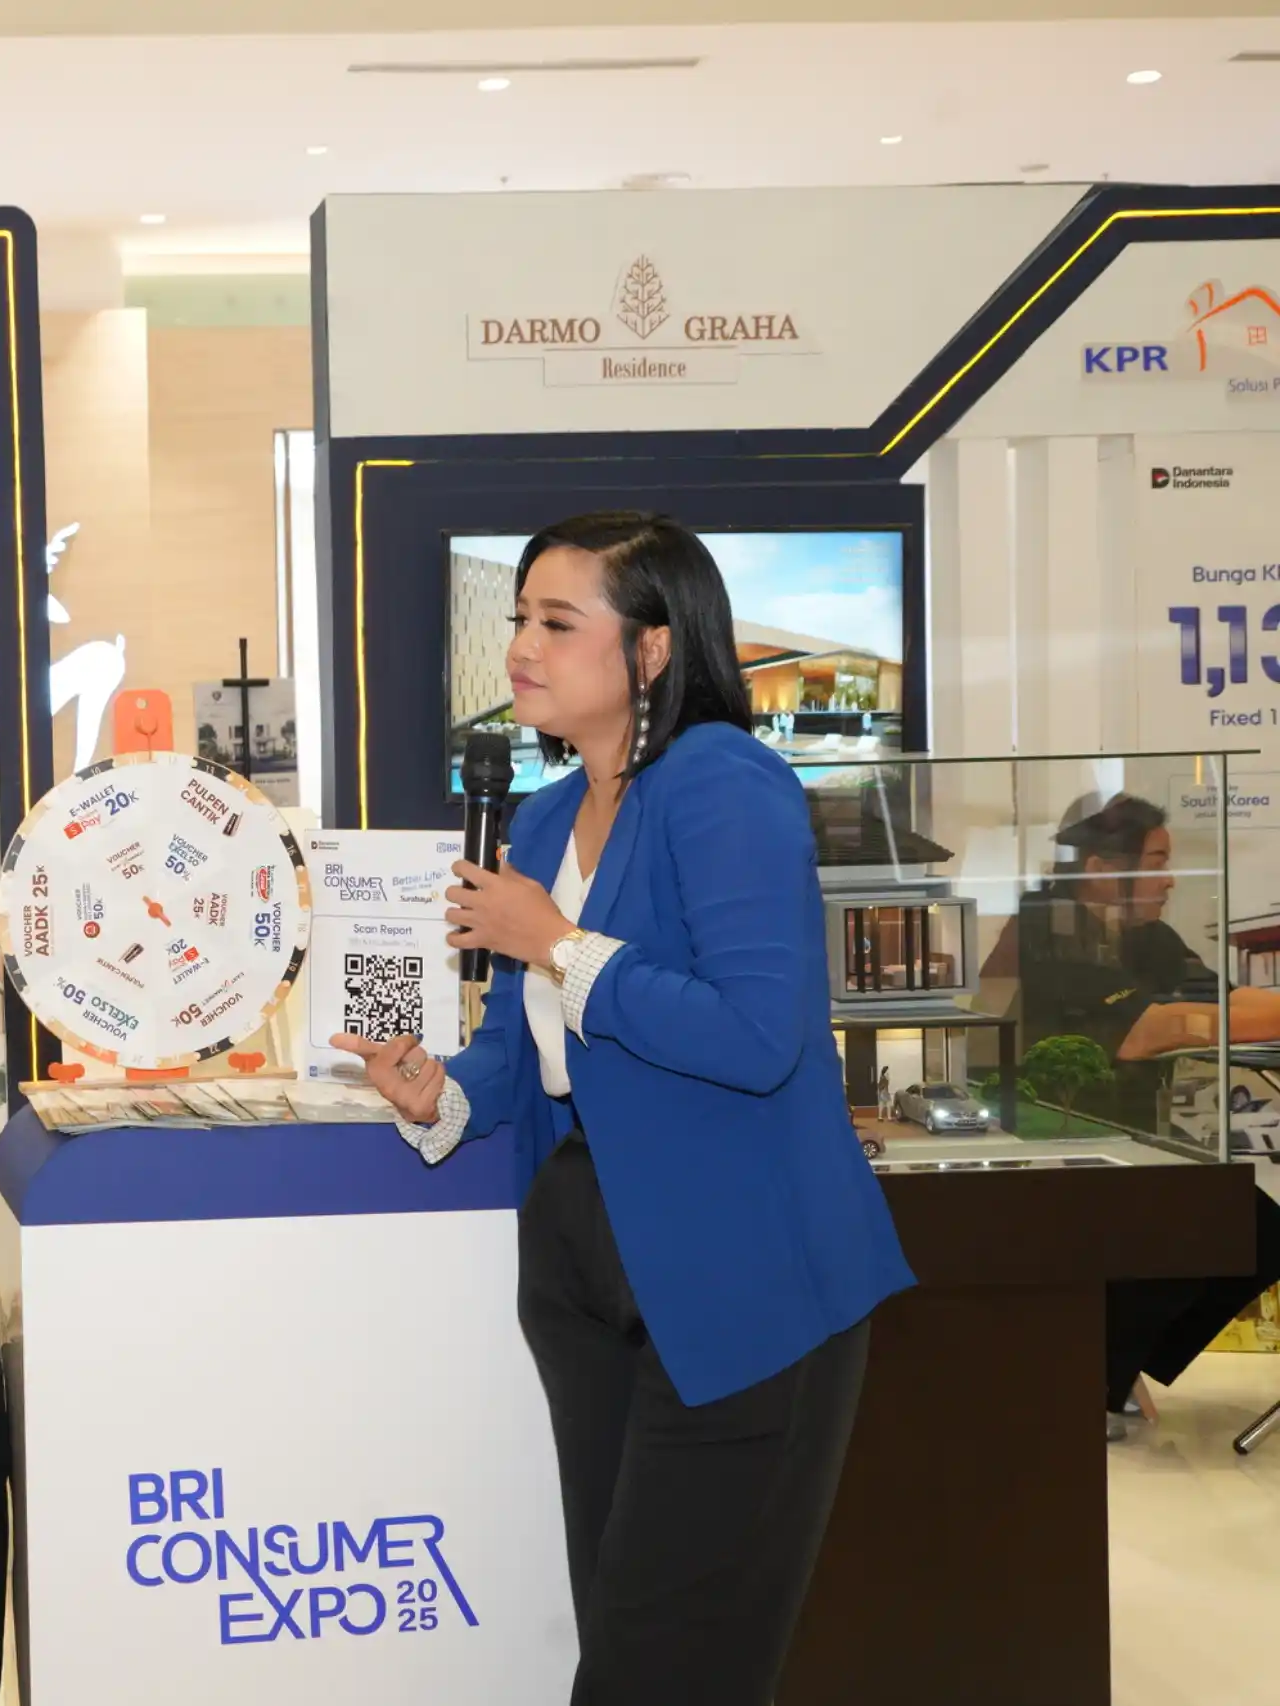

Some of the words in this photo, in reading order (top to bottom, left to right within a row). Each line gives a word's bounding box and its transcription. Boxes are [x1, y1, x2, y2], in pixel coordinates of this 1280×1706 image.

[481, 318, 602, 345] DARMO
[684, 314, 799, 342] GRAHA
[602, 357, 687, 379] Residence
[1084, 345, 1168, 373] KPR
[1228, 377, 1269, 393] Solusi
[1172, 466, 1233, 477] Danantara
[1172, 478, 1230, 489] Indonesia
[1192, 565, 1256, 586] Bunga
[1210, 709, 1262, 727] Fixed
[1270, 708, 1278, 725] 1
[69, 784, 116, 818] E-WALLET
[104, 790, 140, 816] 20K
[180, 789, 221, 825] CANTIK
[187, 778, 230, 816] PULPEN
[106, 841, 141, 864] VOUCHER
[172, 833, 209, 863] VOUCHER
[446, 843, 462, 853] BRI
[31, 864, 49, 898] 25K
[325, 863, 343, 875] BRI
[324, 876, 388, 901] CONSUMER
[340, 889, 372, 901] EXPO
[208, 892, 220, 927] AADK
[23, 905, 33, 957] VOUCHER
[34, 904, 50, 957] AADK
[254, 912, 271, 949] 50K
[271, 901, 282, 953] VOUCHER
[353, 923, 377, 934] Scan
[380, 924, 412, 936] Report
[90, 996, 140, 1031] EXCELSO
[170, 1002, 204, 1028] 50K
[200, 991, 244, 1028] VOUCHER
[82, 1009, 128, 1042] VOUCHER
[128, 1467, 225, 1525] BRI
[126, 1514, 480, 1627] CONSUMER
[396, 1578, 438, 1604] 20
[219, 1583, 387, 1645] EXPO
[397, 1606, 439, 1632] 25
